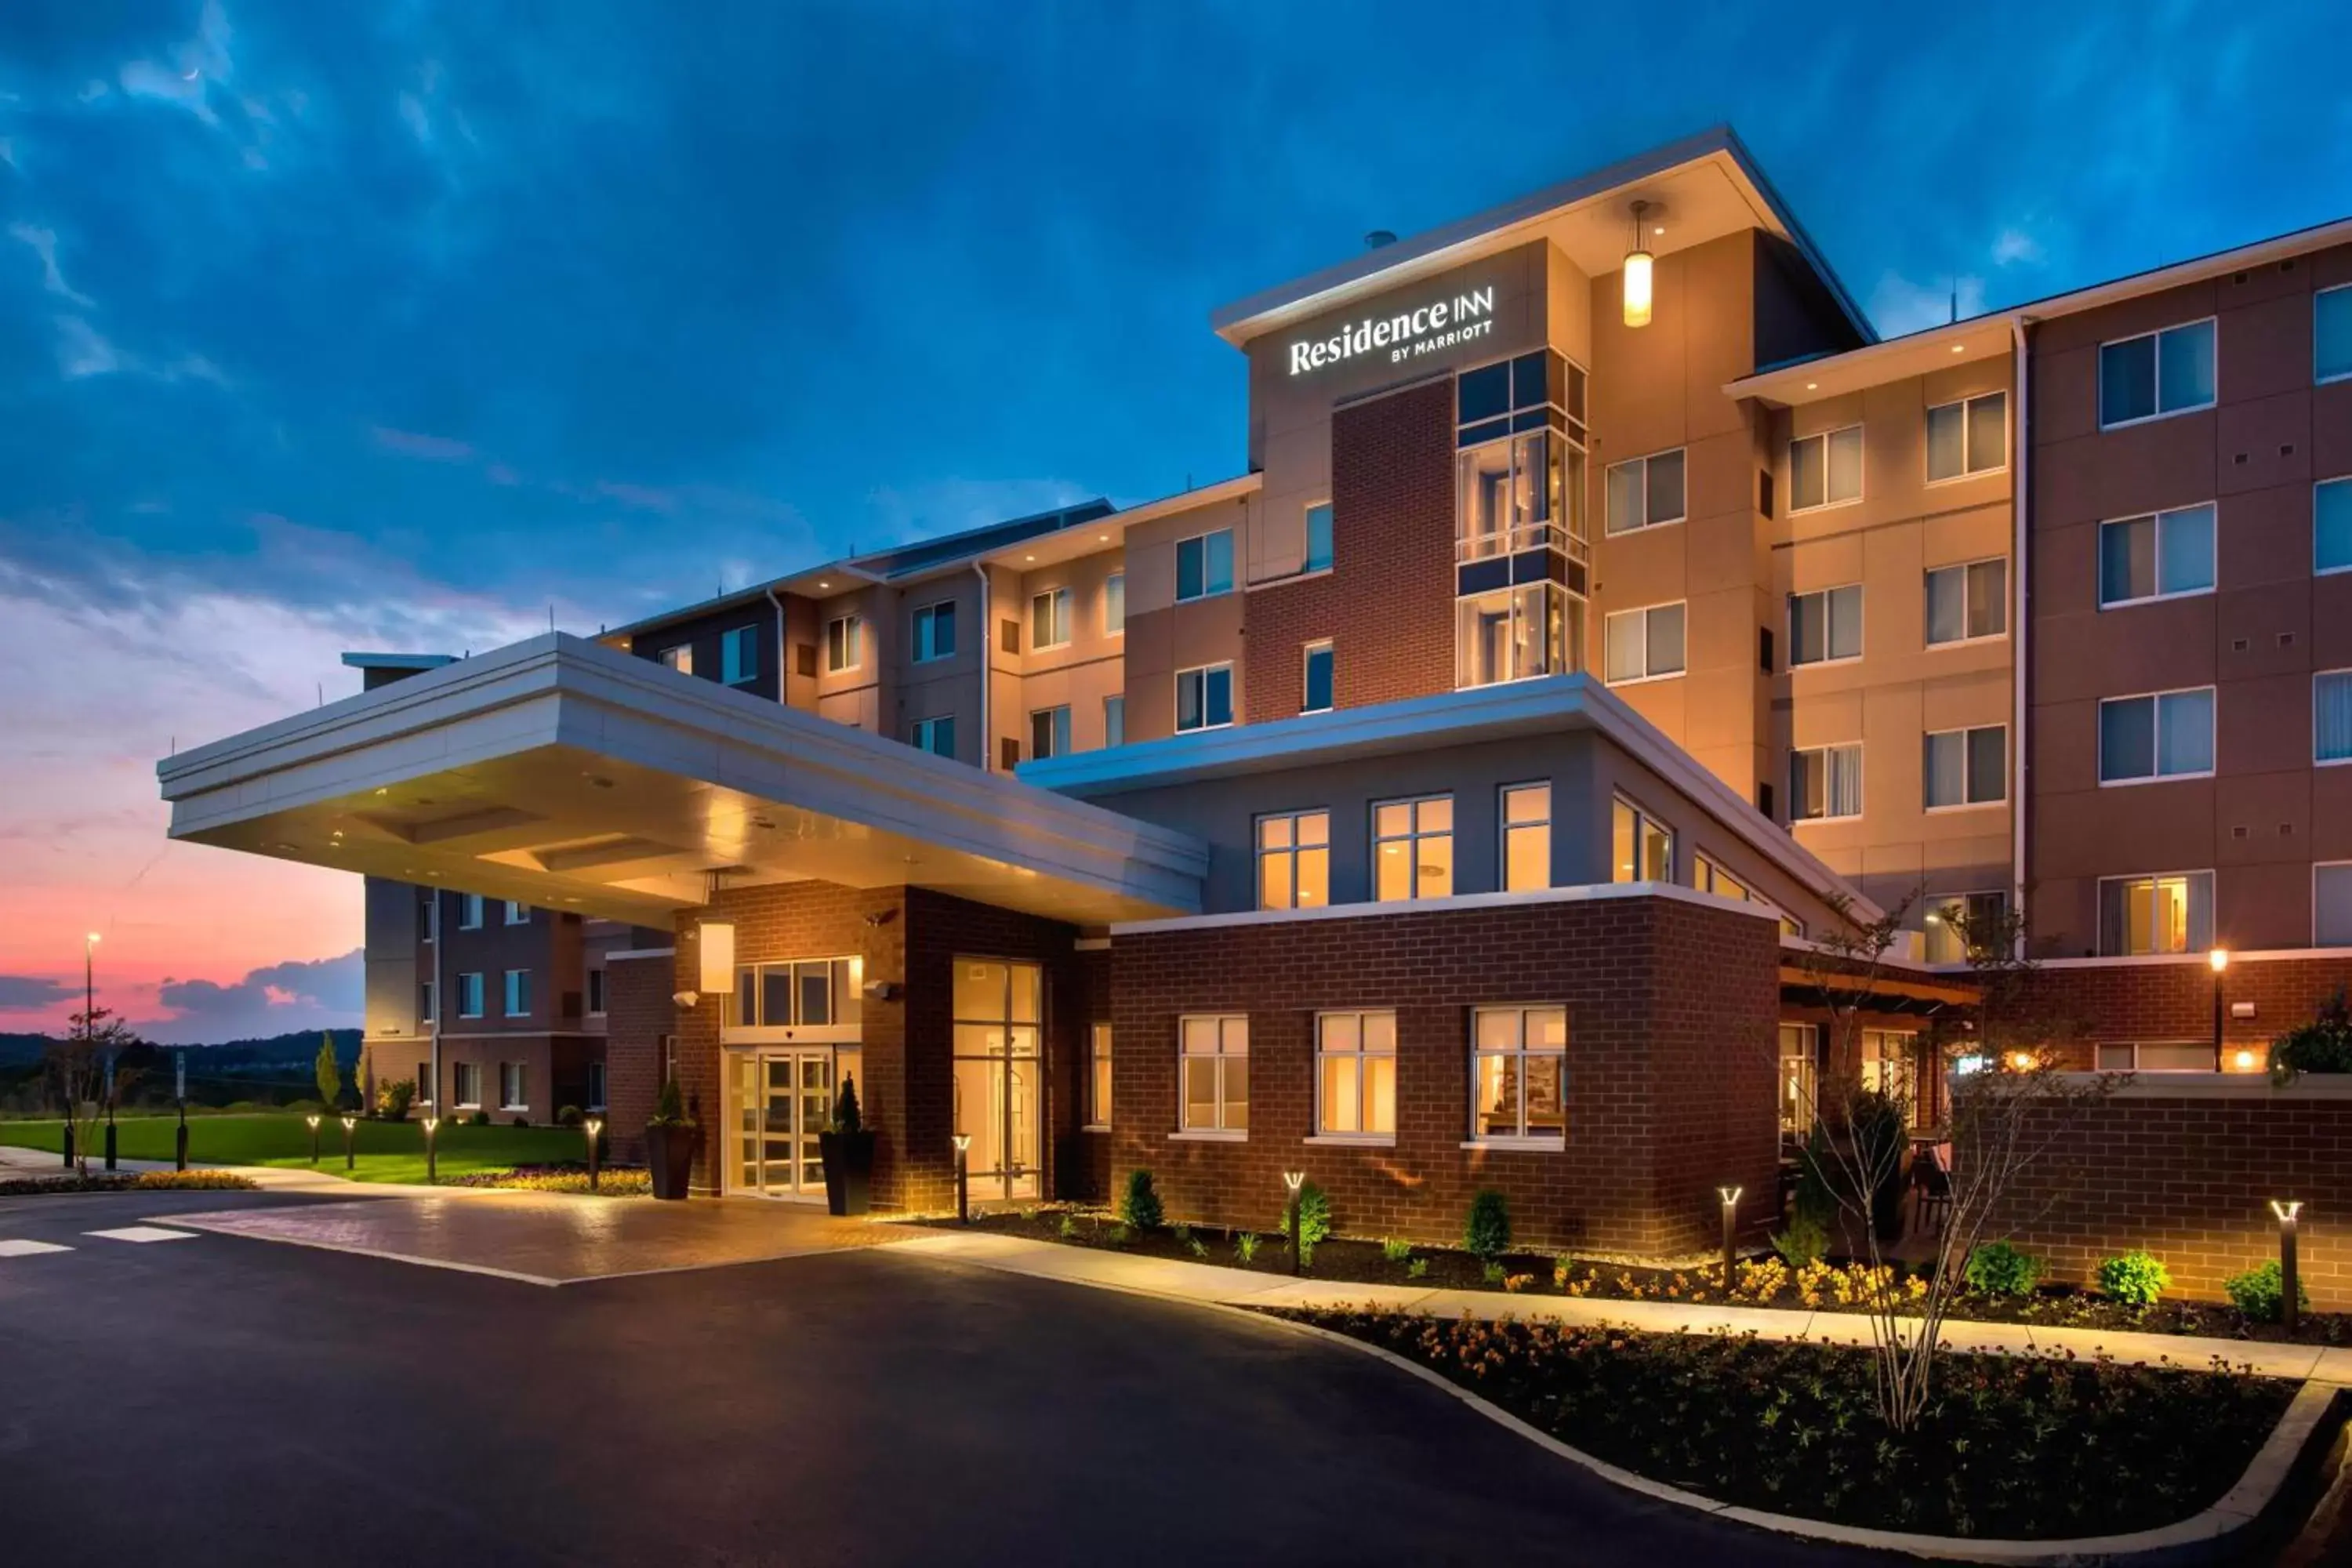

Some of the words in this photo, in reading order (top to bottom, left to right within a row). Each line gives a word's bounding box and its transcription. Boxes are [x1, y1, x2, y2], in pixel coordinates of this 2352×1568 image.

[1289, 302, 1448, 376] Residence
[1454, 286, 1493, 322] INN
[1392, 348, 1410, 363] BY
[1414, 320, 1493, 355] MARRIOTT
